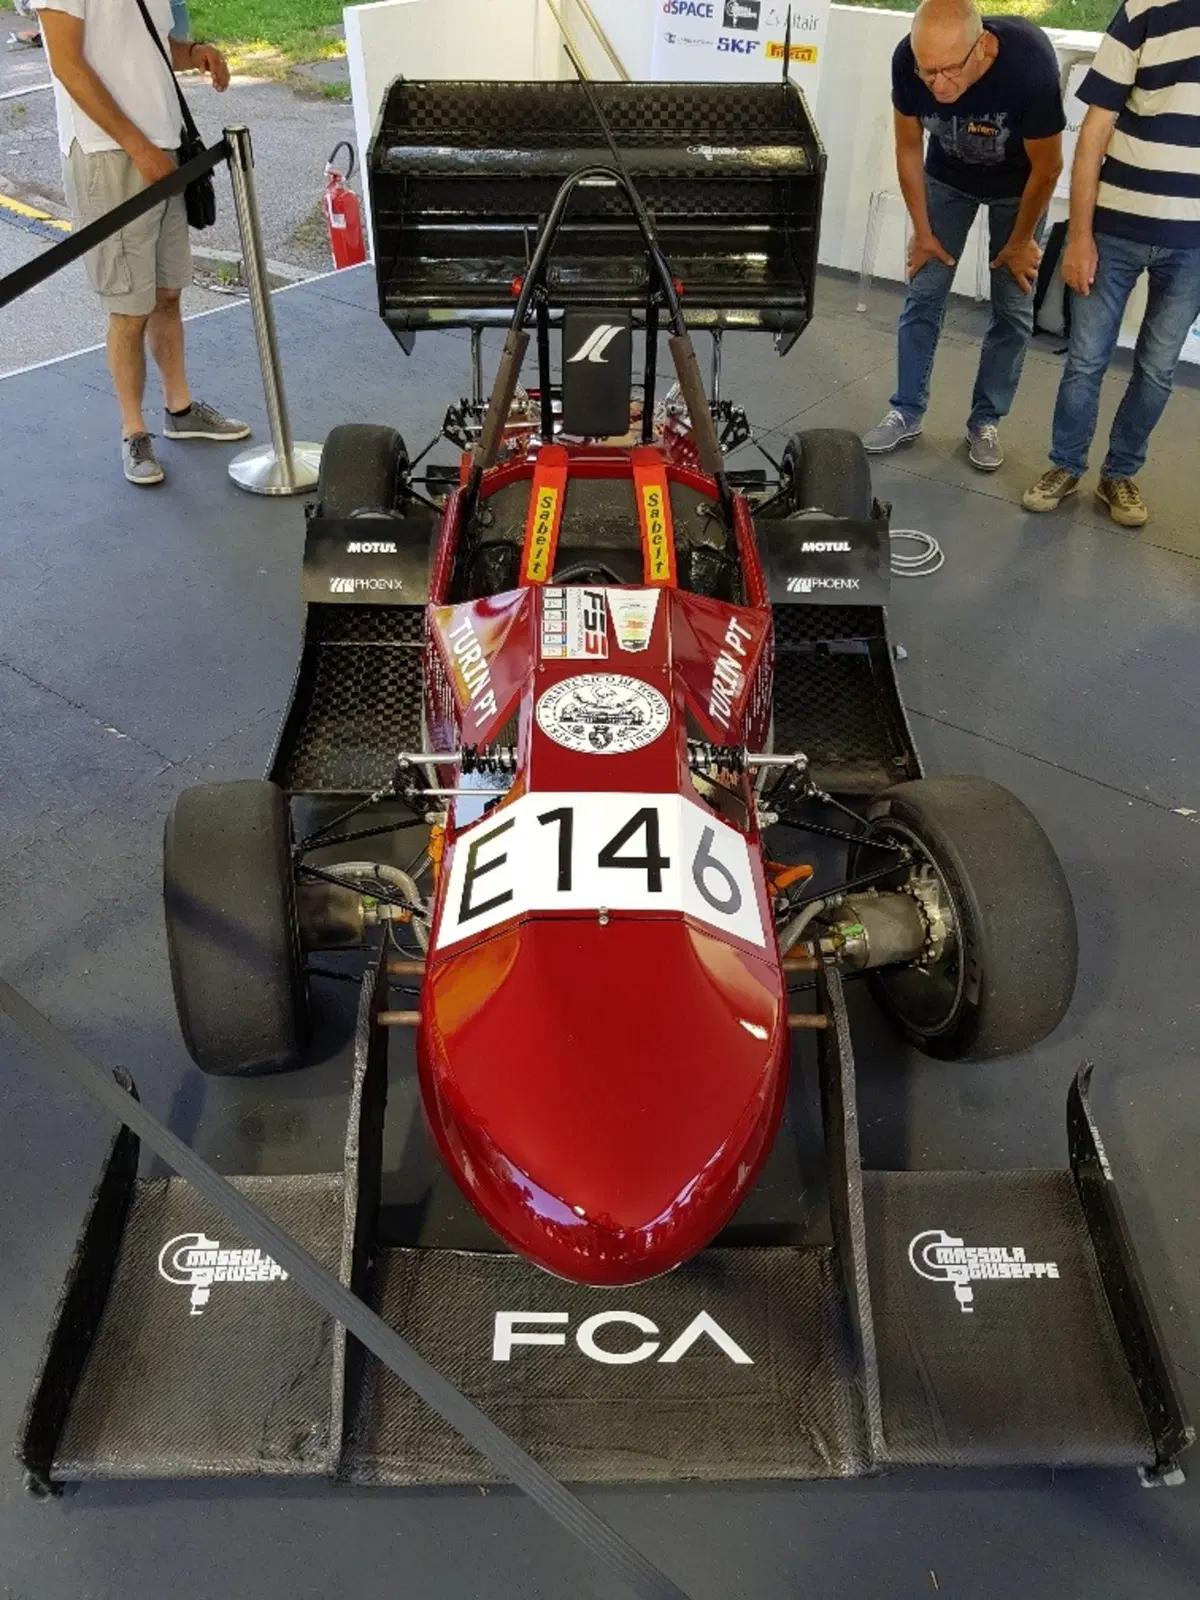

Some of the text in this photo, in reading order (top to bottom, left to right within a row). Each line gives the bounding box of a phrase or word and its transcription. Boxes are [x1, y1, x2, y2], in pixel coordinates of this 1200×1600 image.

[662, 0, 714, 18] dSPACE
[717, 37, 760, 54] SKF
[532, 495, 553, 574] Sabelt
[647, 493, 665, 574] Sabelt
[347, 542, 398, 553] MOTUL
[801, 542, 851, 552] MOTUL
[355, 579, 403, 590] PHOENIX
[812, 578, 860, 590] PHOENIX
[449, 616, 497, 728] TURIN PT
[709, 616, 751, 719] TURIN PT
[936, 1247, 1026, 1264] MASSOLA
[968, 1262, 1060, 1279] GIUSEPPE
[492, 1310, 755, 1364] FCA
